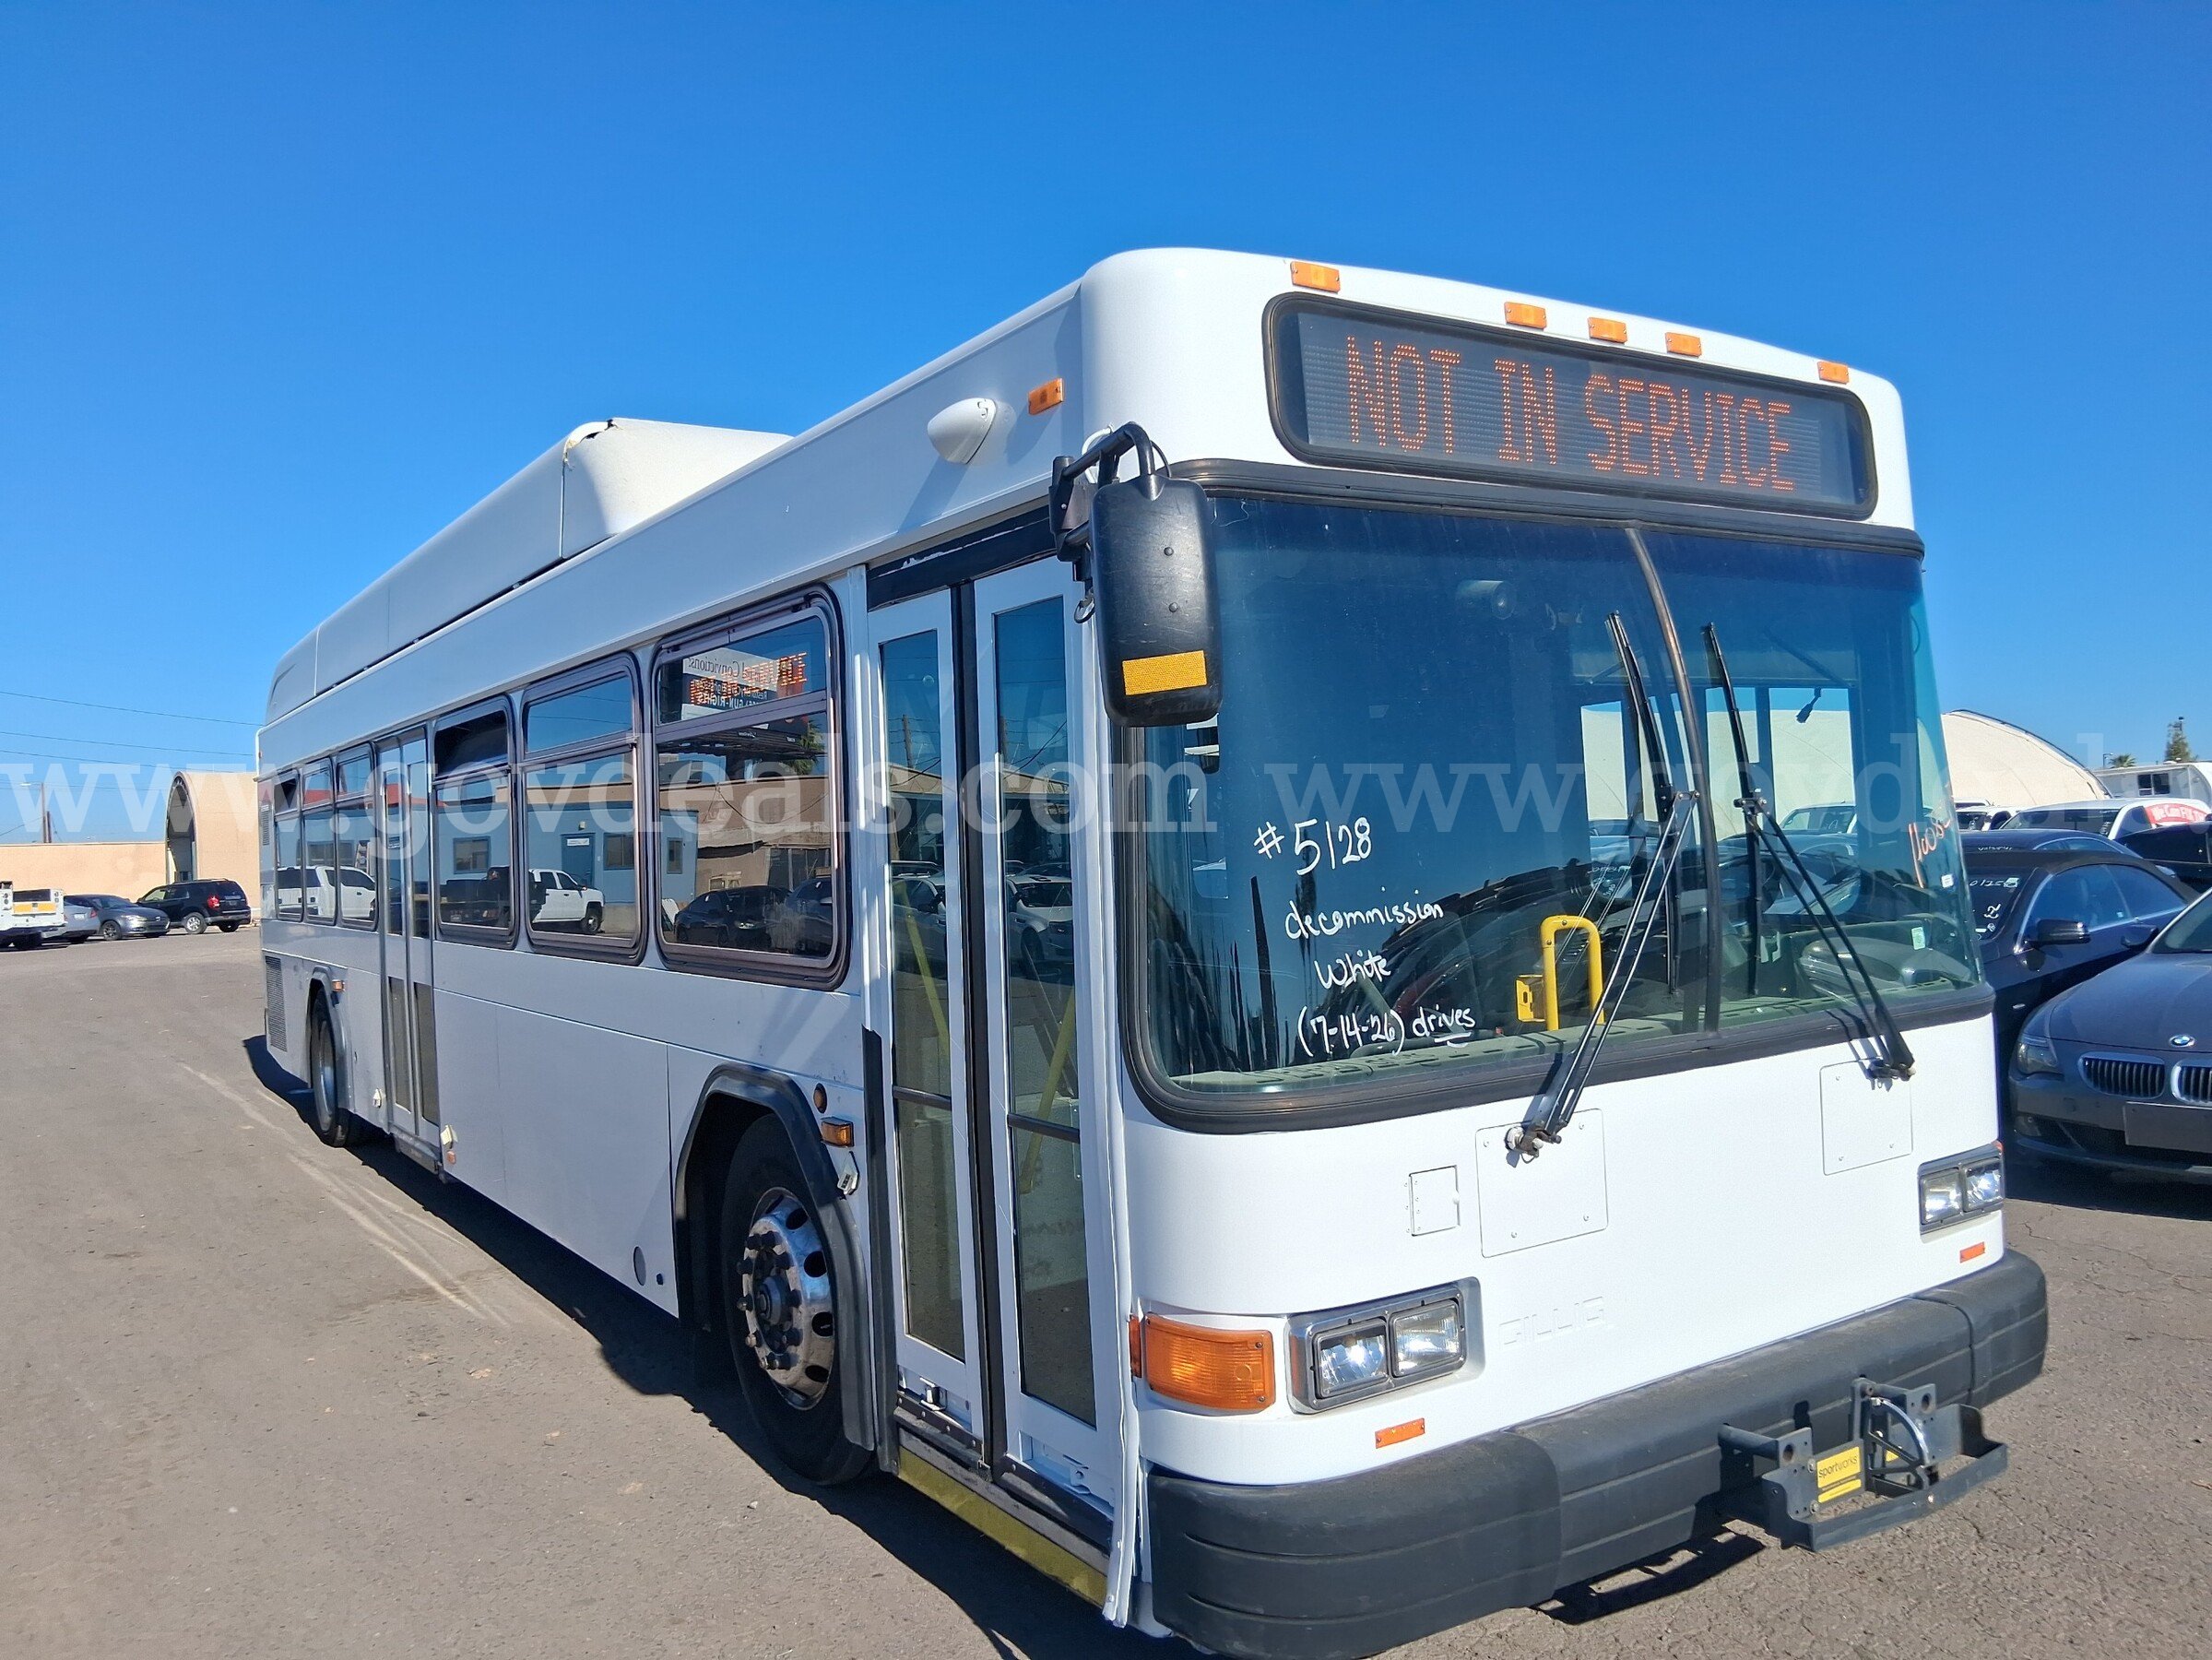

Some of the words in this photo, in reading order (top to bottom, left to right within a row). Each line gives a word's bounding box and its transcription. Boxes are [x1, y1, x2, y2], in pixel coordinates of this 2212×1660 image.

[1345, 335, 1461, 454] NOT
[1494, 358, 1558, 466] IN
[1583, 373, 1795, 492] SERVICE
[1284, 887, 1445, 940] decommission
[1412, 1004, 1475, 1037] drives
